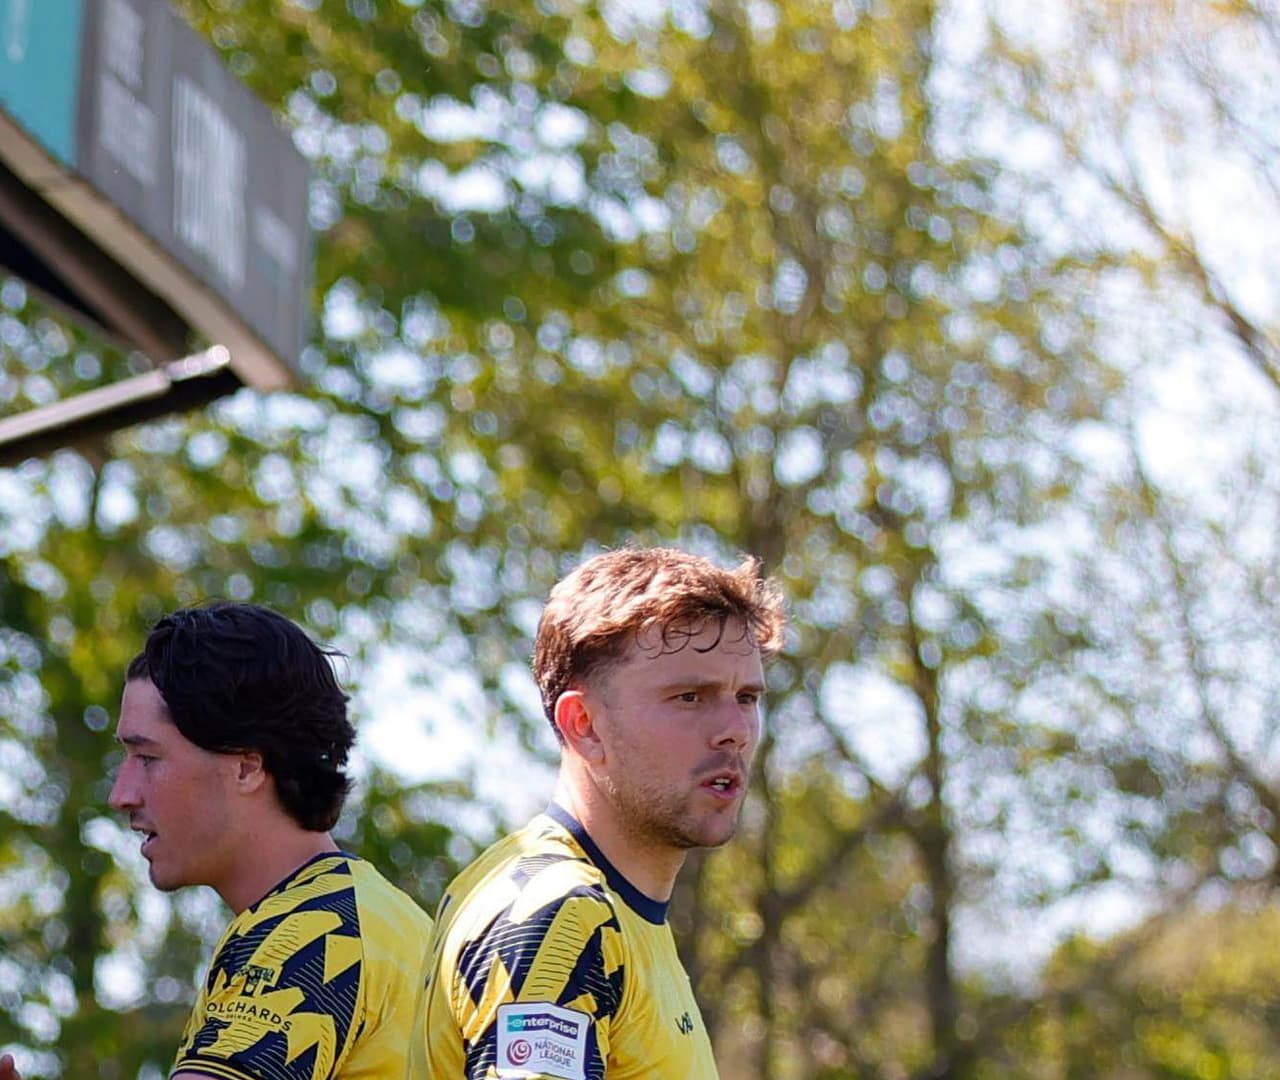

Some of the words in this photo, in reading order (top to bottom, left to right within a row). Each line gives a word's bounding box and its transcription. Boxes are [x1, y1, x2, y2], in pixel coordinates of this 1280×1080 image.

[508, 1016, 579, 1037] enterprise
[534, 1041, 577, 1060] NATIONAL
[540, 1050, 572, 1068] LEAGUE
